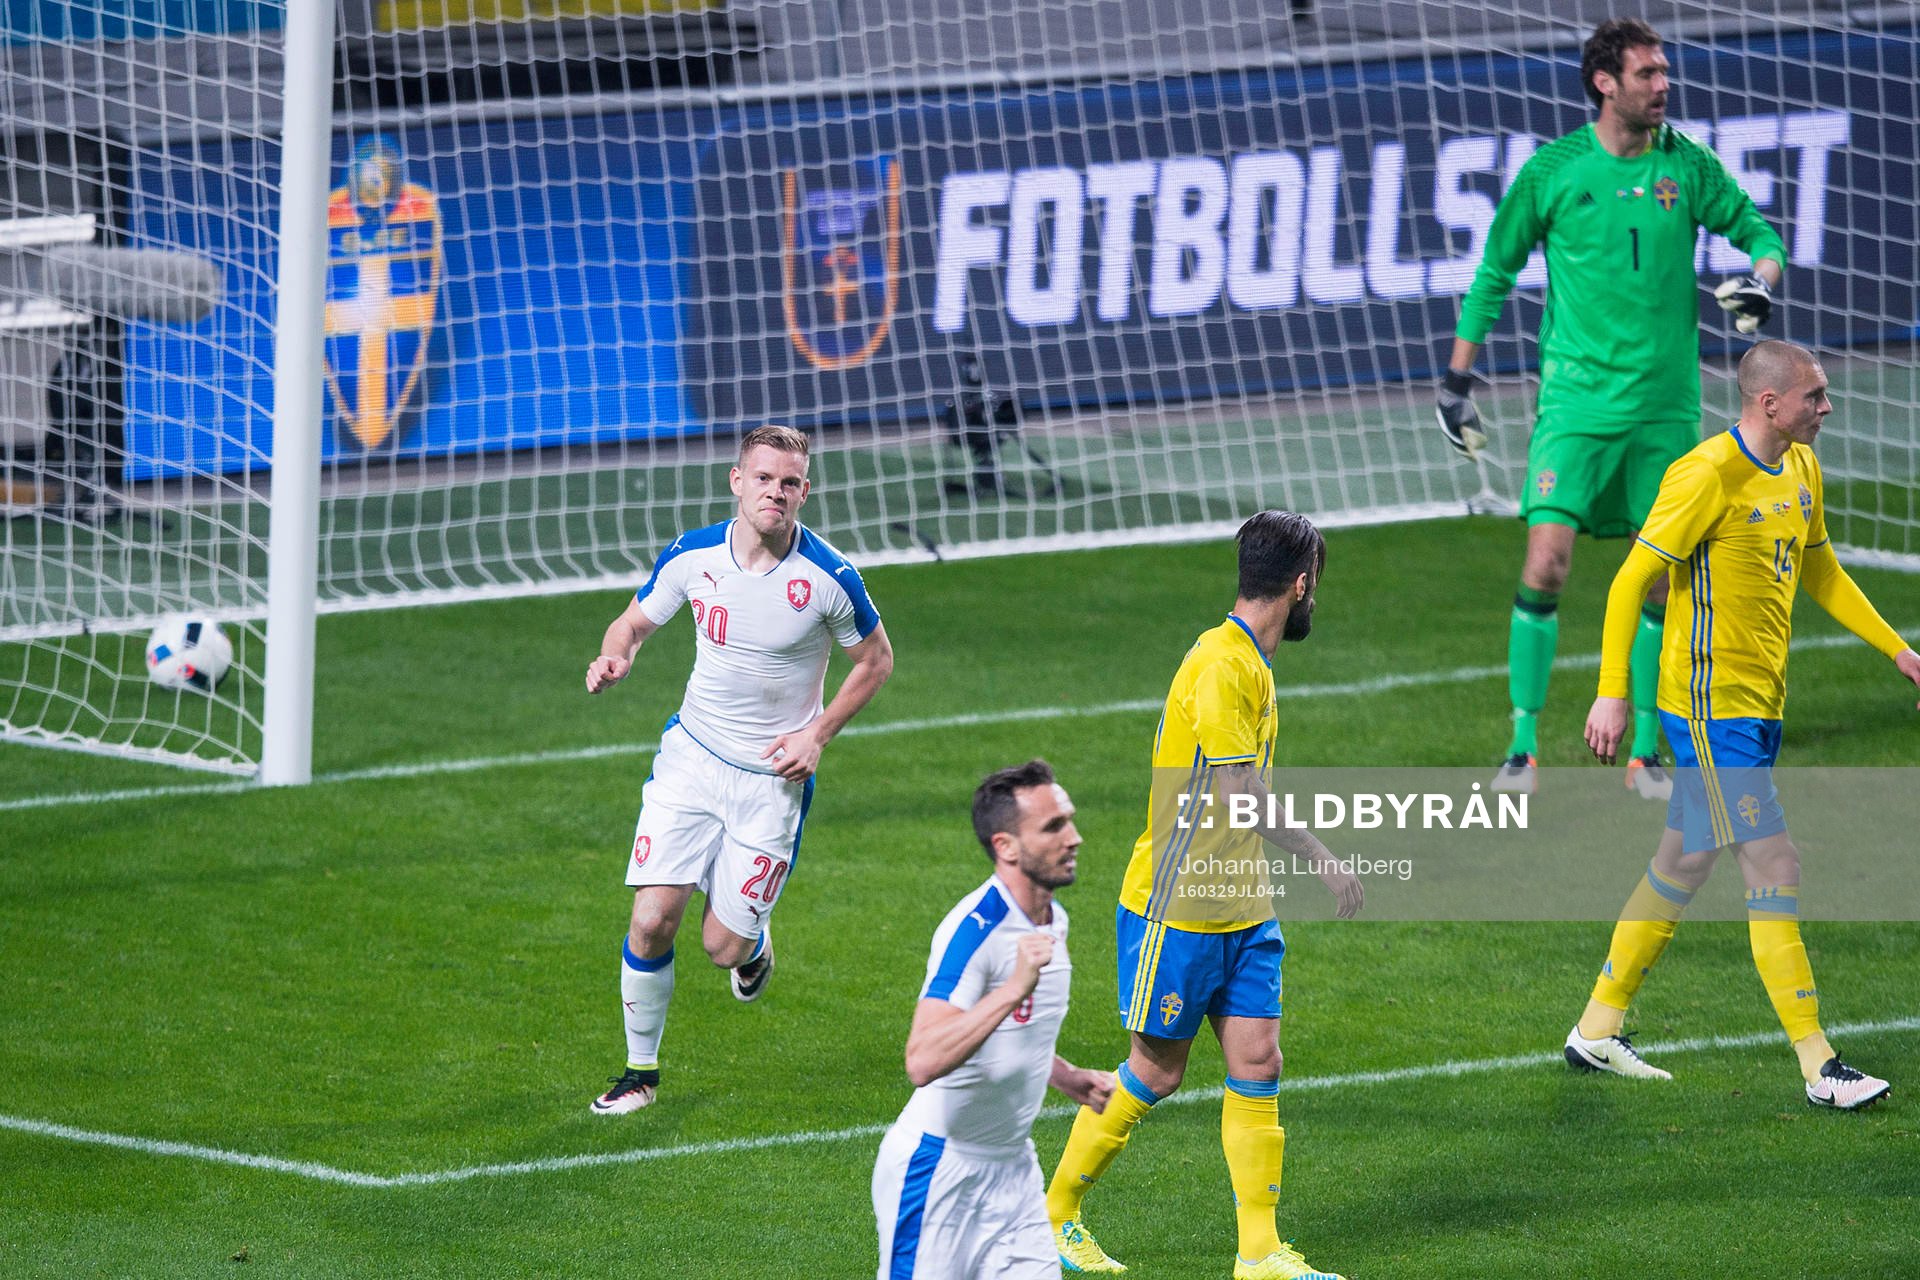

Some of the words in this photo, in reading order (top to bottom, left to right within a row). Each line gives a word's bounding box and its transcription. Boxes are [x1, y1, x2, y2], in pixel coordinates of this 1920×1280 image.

[1628, 227, 1640, 272] 1
[1774, 536, 1797, 583] 14
[741, 856, 788, 903] 20
